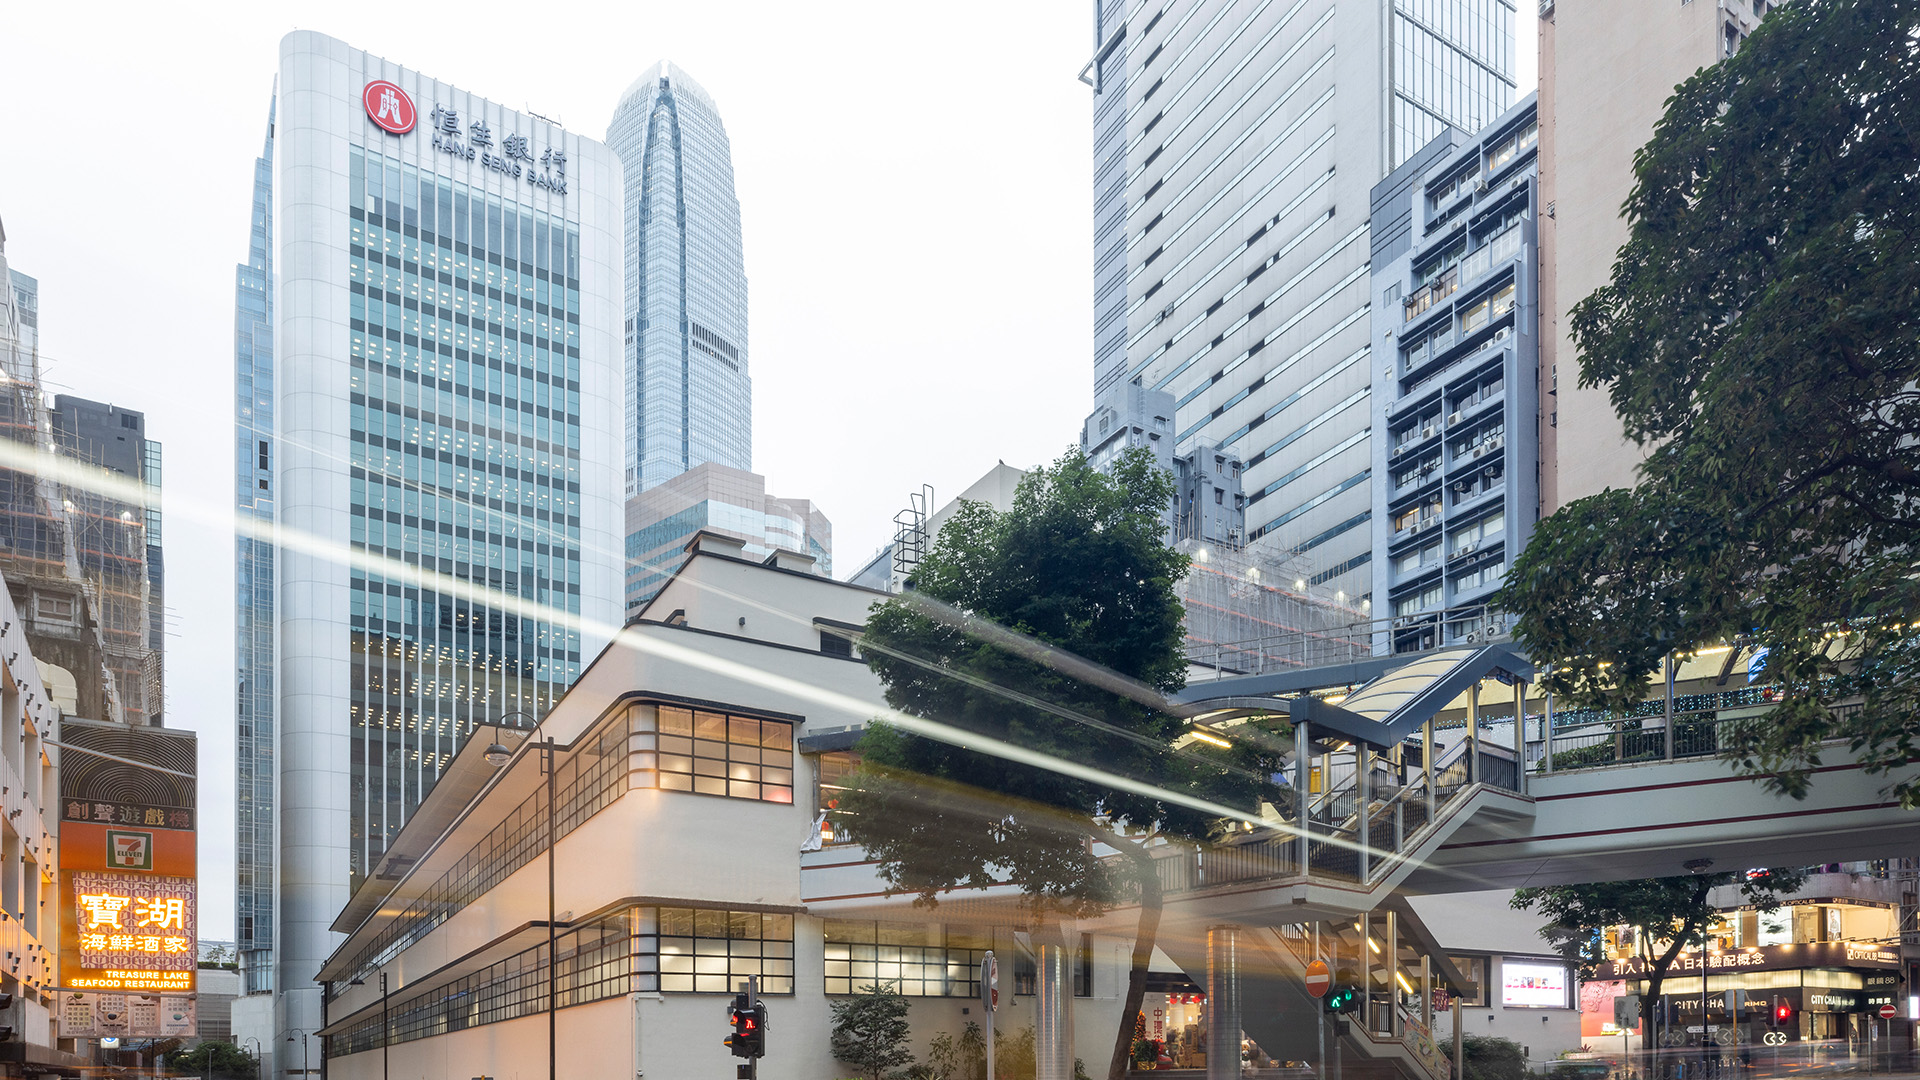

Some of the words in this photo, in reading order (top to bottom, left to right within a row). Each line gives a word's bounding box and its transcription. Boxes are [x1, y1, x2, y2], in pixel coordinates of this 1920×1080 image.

[430, 102, 568, 176] 恒生銀行
[431, 133, 476, 161] HANG
[481, 152, 522, 178] SENG
[527, 168, 568, 195] BANK
[67, 801, 190, 828] 創聲遊戲機
[80, 893, 184, 930] 寶湖
[81, 933, 188, 953] 海鮮酒家
[71, 979, 121, 988] SEAFOOD
[124, 980, 190, 989] RESTAURANT
[105, 971, 159, 979] TREASURE
[163, 972, 190, 980] LAKE
[1811, 994, 1824, 1005] CITY
